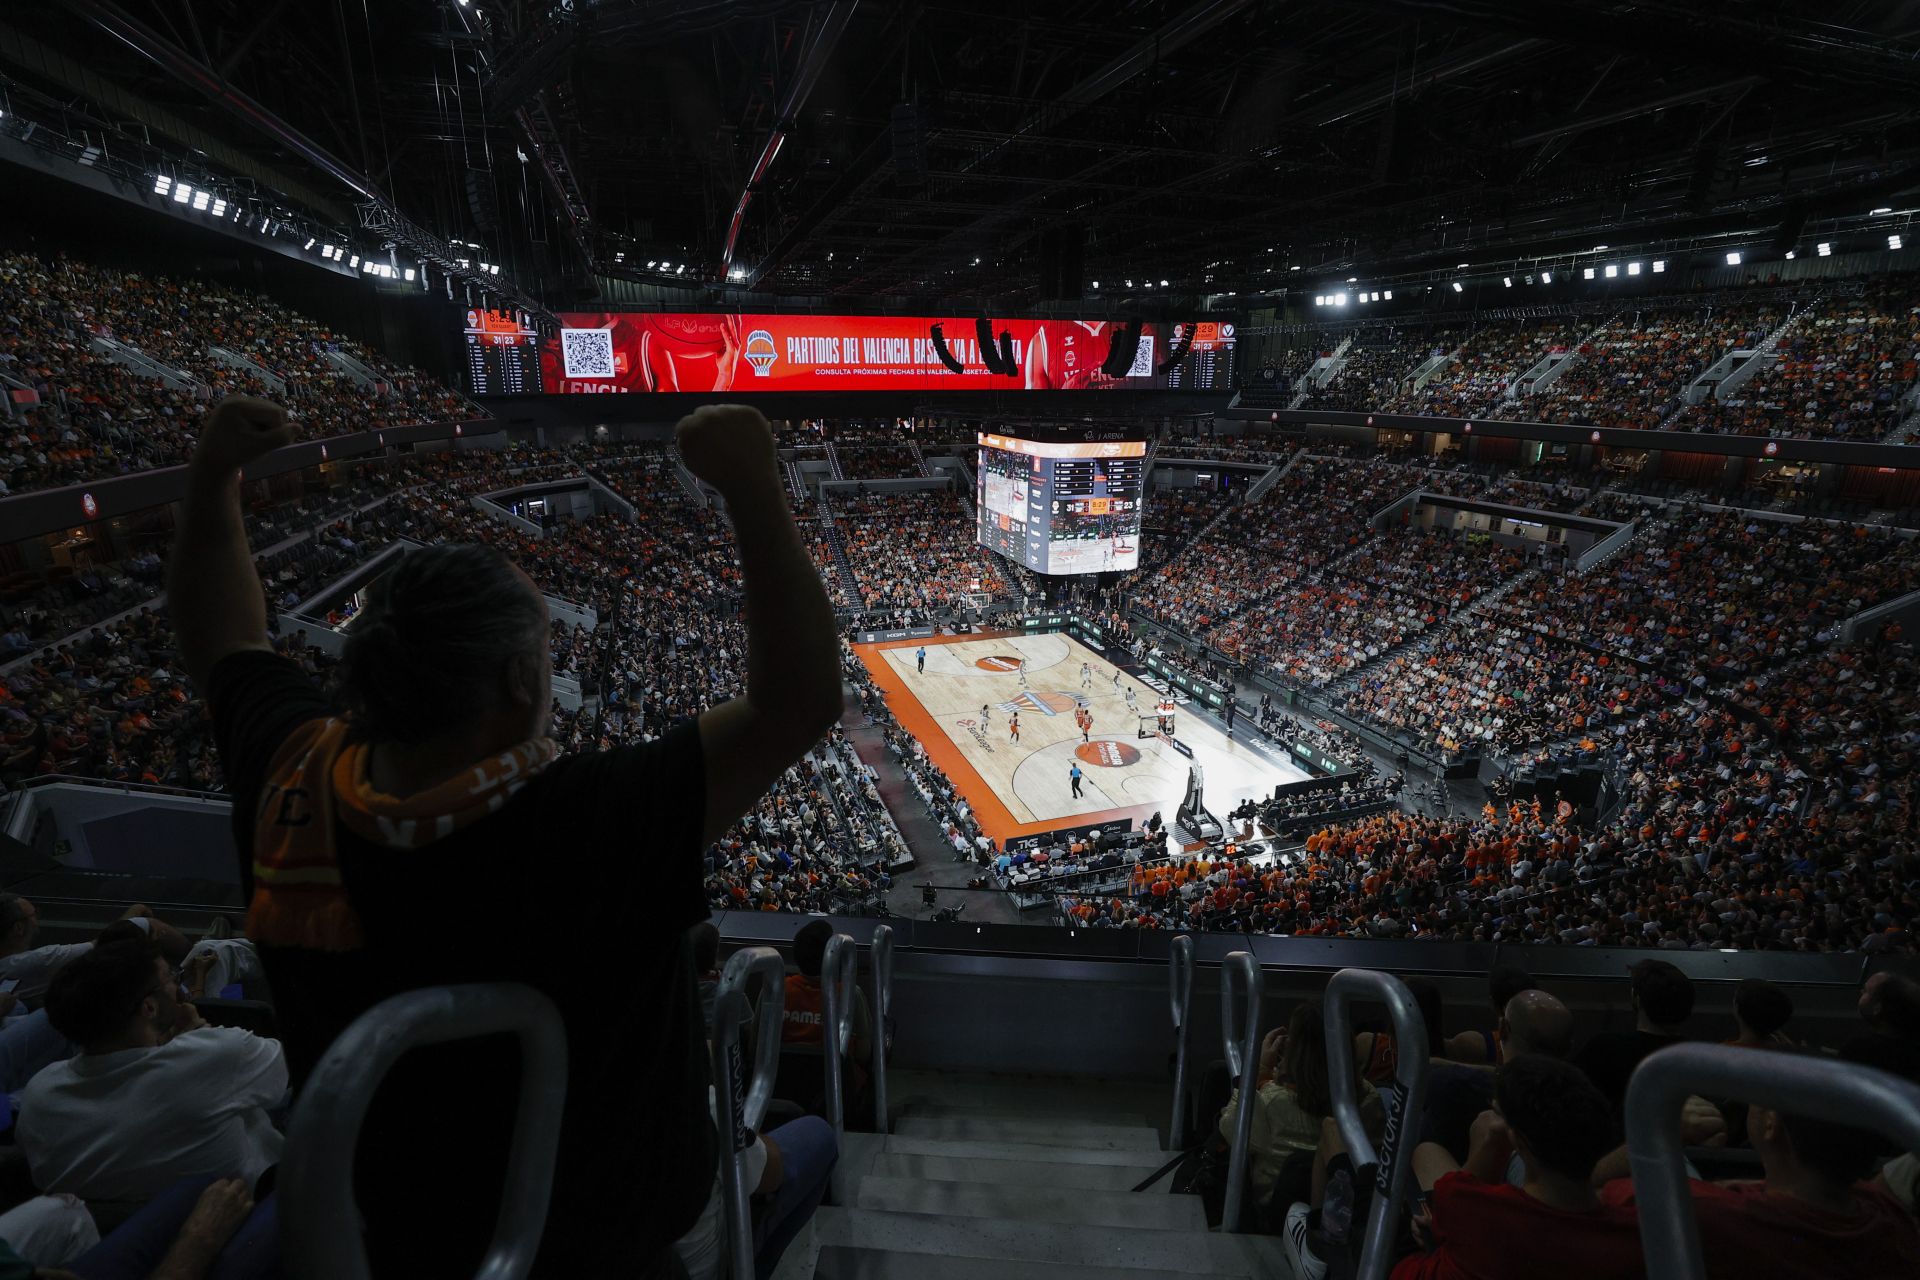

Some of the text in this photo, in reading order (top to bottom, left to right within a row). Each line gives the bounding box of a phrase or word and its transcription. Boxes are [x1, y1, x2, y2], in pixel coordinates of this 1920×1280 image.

[494, 336, 514, 344] 31 23
[787, 337, 840, 364] PARTIDOS
[843, 337, 860, 364] DEL
[863, 338, 911, 365] VALENCIA
[953, 338, 967, 365] YA
[968, 338, 977, 365] A
[853, 367, 887, 375] PRÓXIMAS
[1066, 504, 1075, 512] 31
[1123, 502, 1134, 510] 23
[1226, 845, 1236, 855] 22
[1376, 1112, 1399, 1190] SECTOR
